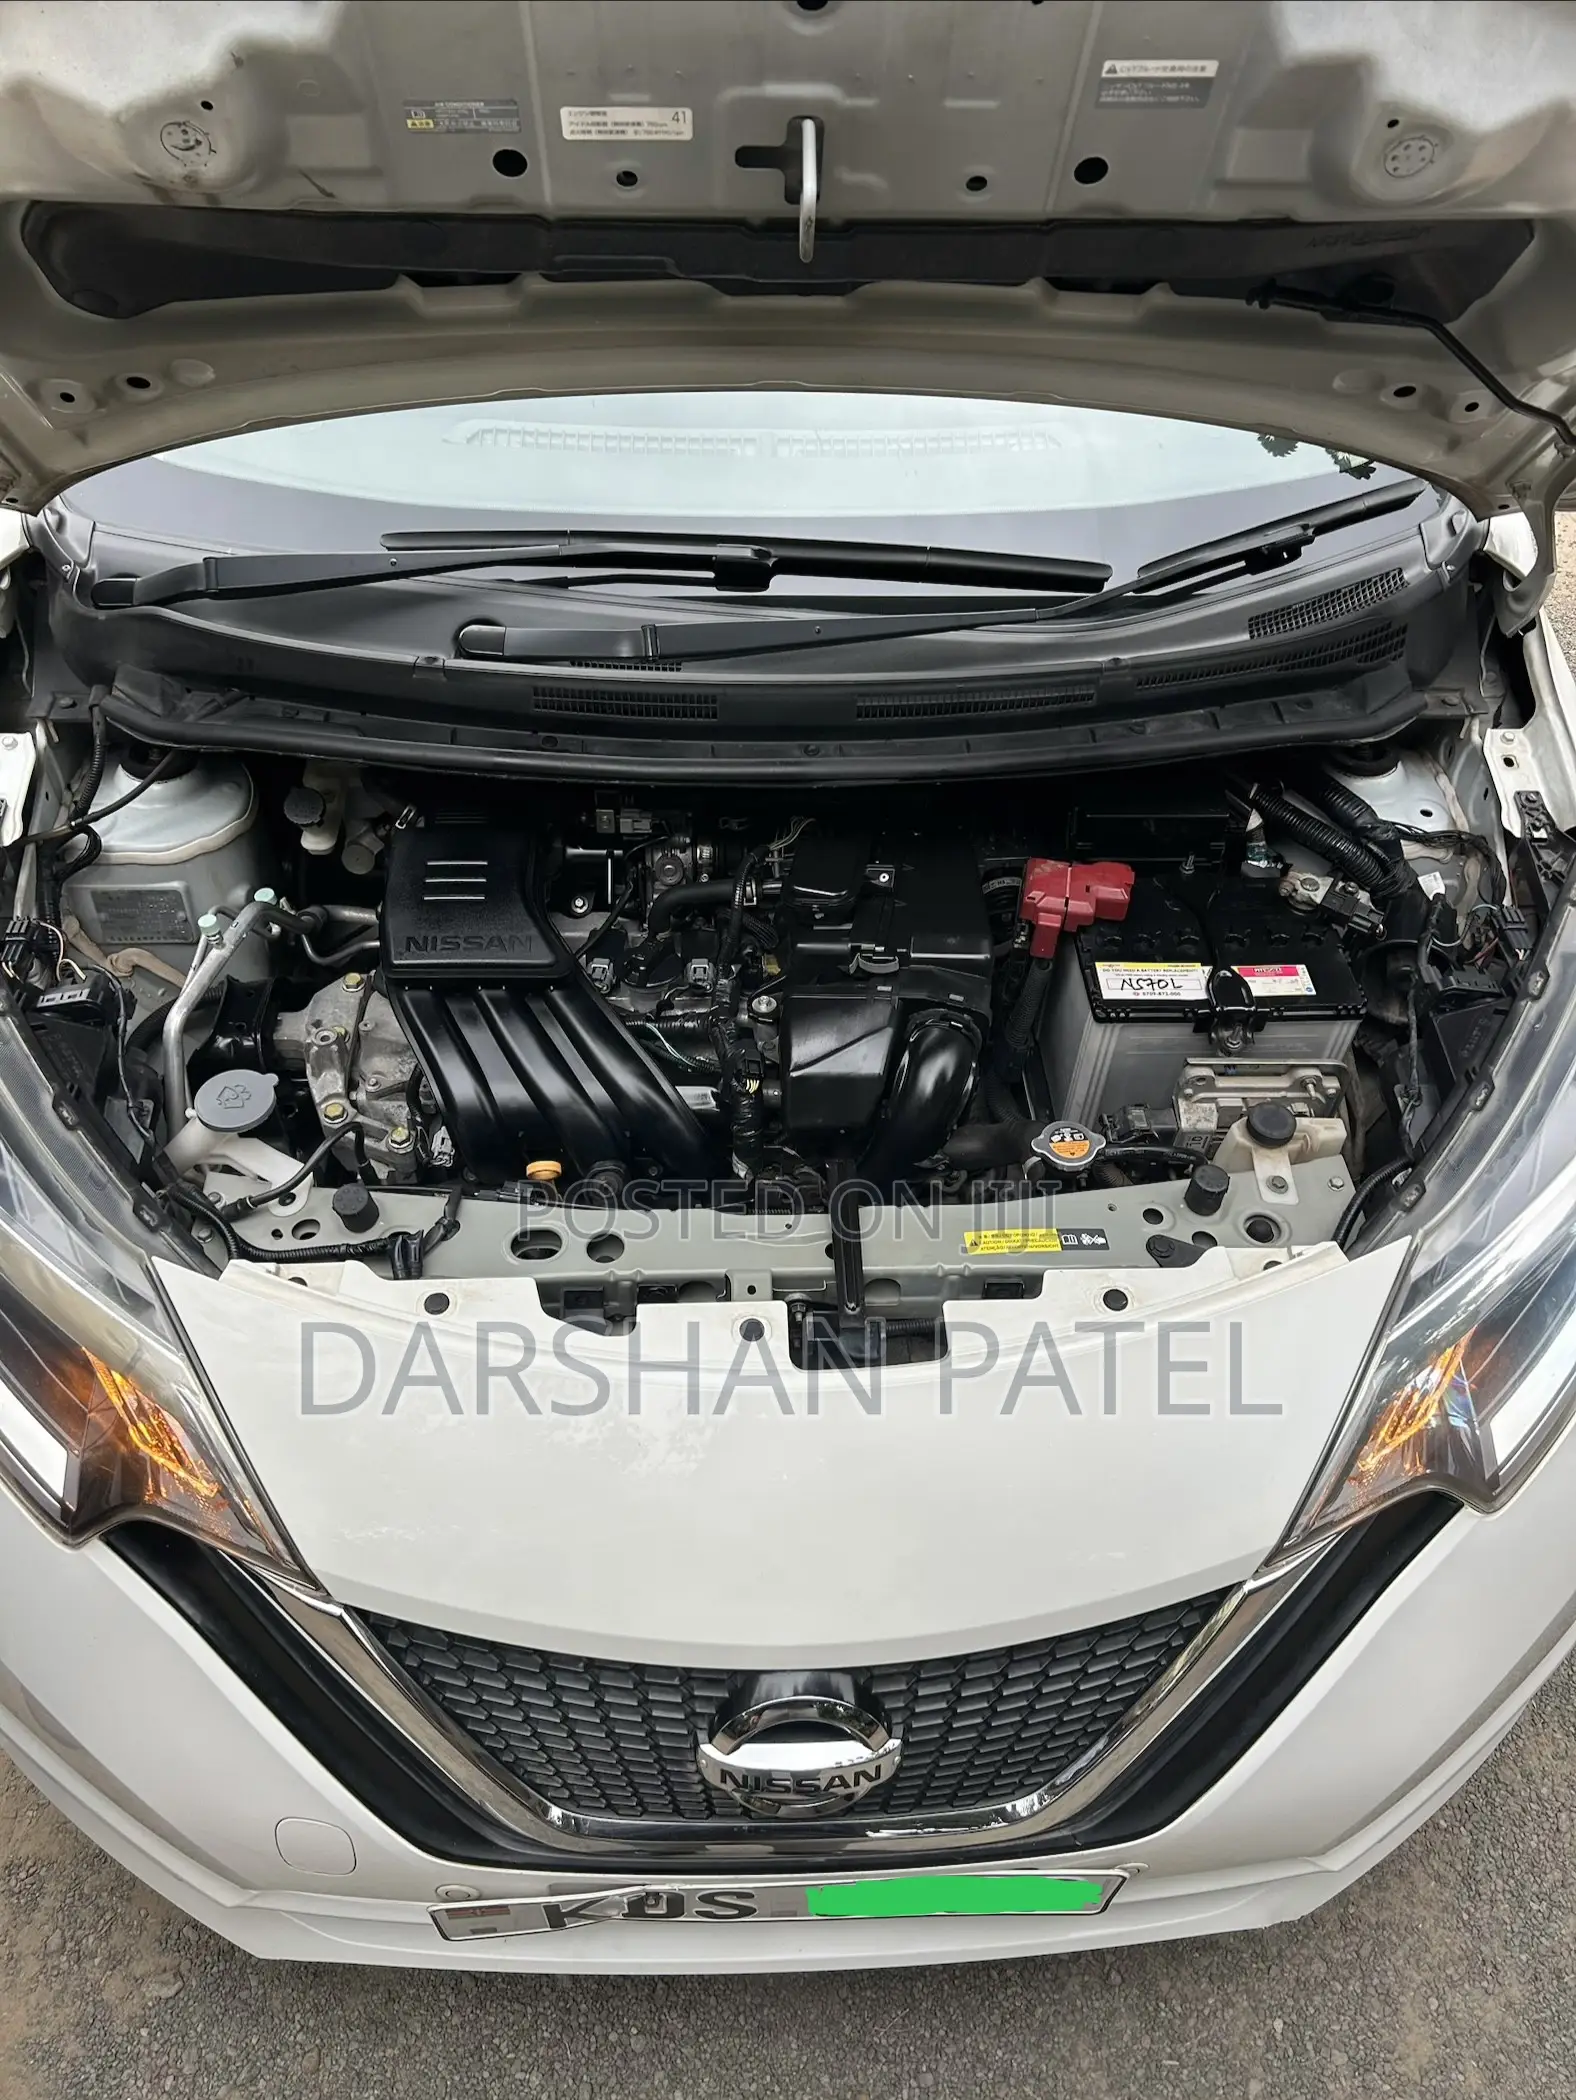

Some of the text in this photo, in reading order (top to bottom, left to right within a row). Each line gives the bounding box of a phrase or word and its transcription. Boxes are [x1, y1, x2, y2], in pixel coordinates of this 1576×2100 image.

[671, 110, 687, 124] 41
[404, 935, 532, 952] NISSAN
[1120, 977, 1183, 991] NS70L
[720, 1763, 882, 1797] NISSAN
